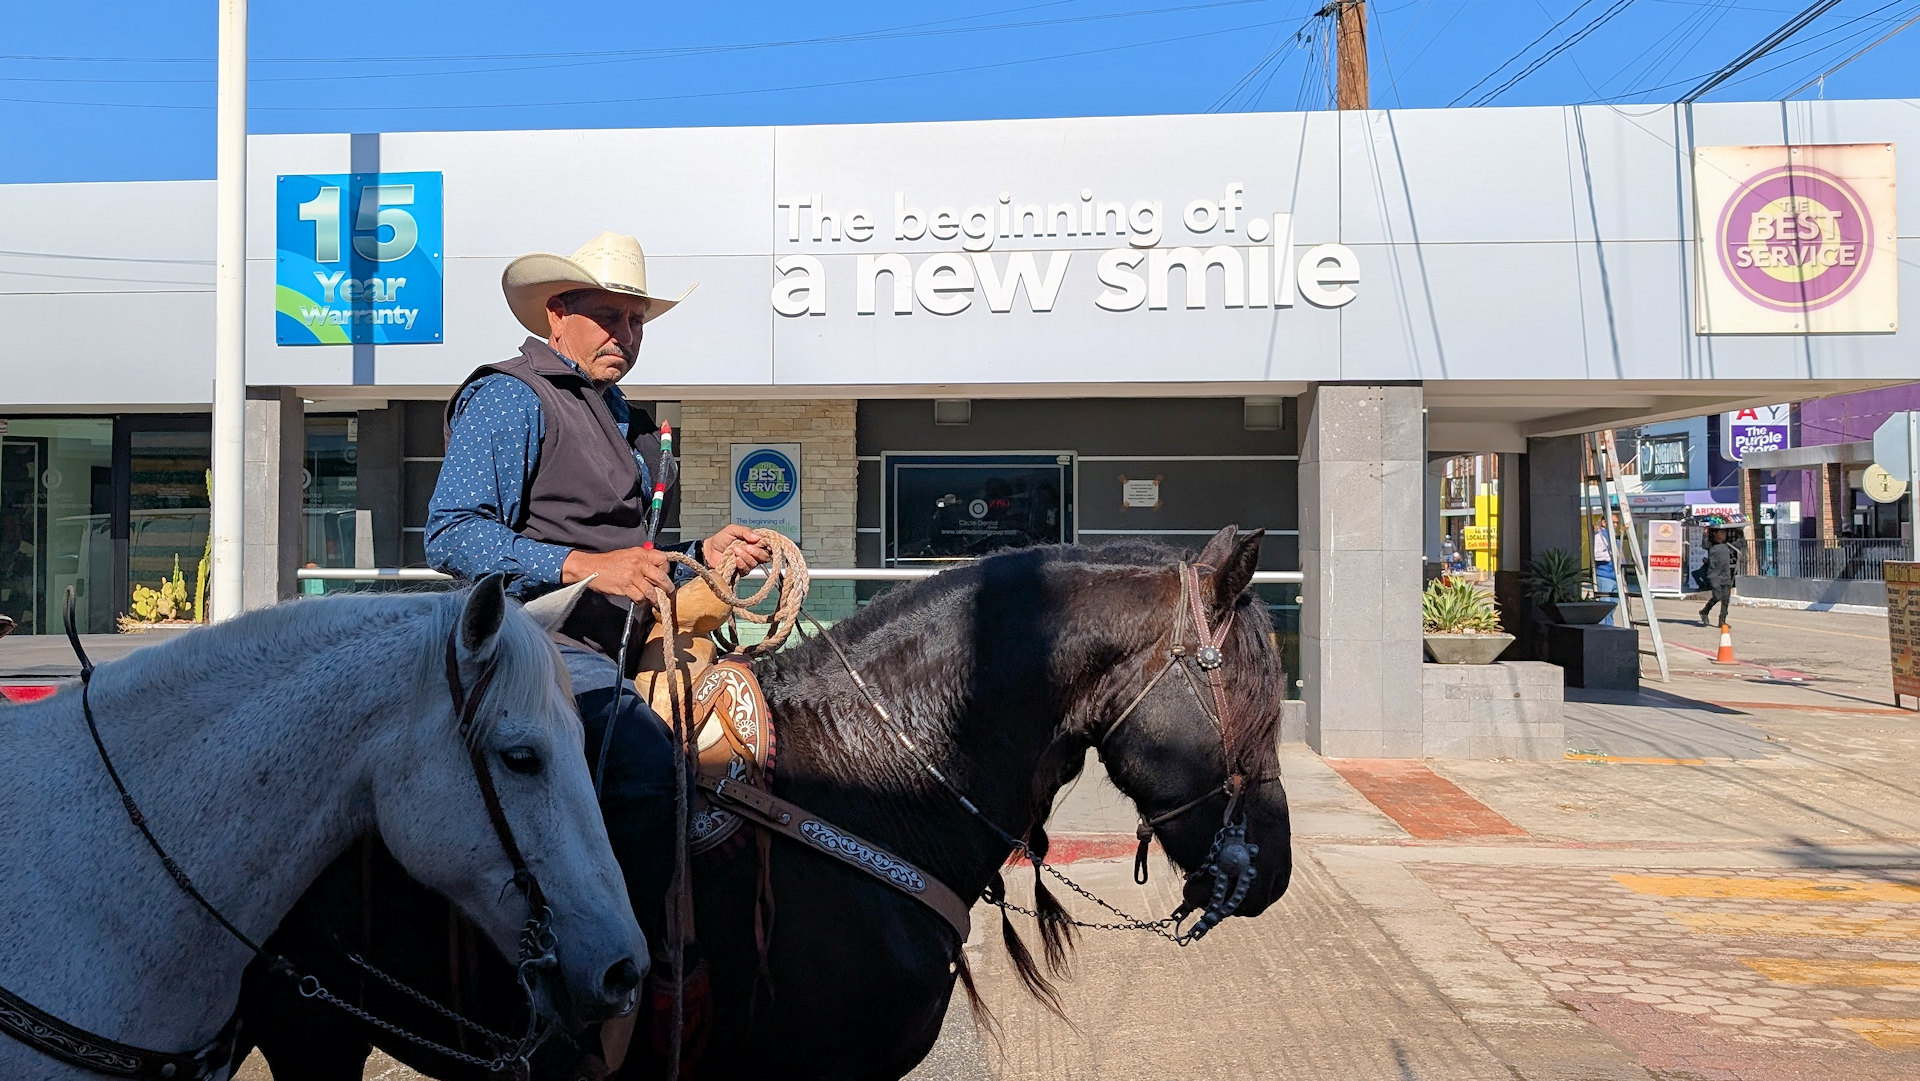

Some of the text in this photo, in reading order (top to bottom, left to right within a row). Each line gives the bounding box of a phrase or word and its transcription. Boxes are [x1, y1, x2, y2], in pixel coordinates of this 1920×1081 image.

[1780, 201, 1809, 212] THE
[299, 184, 418, 263] 15
[778, 182, 1244, 251] The beginning of
[1751, 210, 1843, 241] BEST
[771, 212, 1360, 318] a new smile
[1736, 245, 1857, 268] SERVICE
[313, 271, 407, 303] Year
[300, 306, 419, 330] Warranty
[1735, 431, 1782, 448] Purple
[1745, 426, 1768, 437] The
[748, 467, 785, 481] BEST
[742, 482, 790, 492] SERVICE
[1695, 507, 1734, 515] ARIZONA
[736, 517, 746, 525] The
[748, 517, 778, 526] beginning
[1651, 556, 1681, 564] WALK-INS
